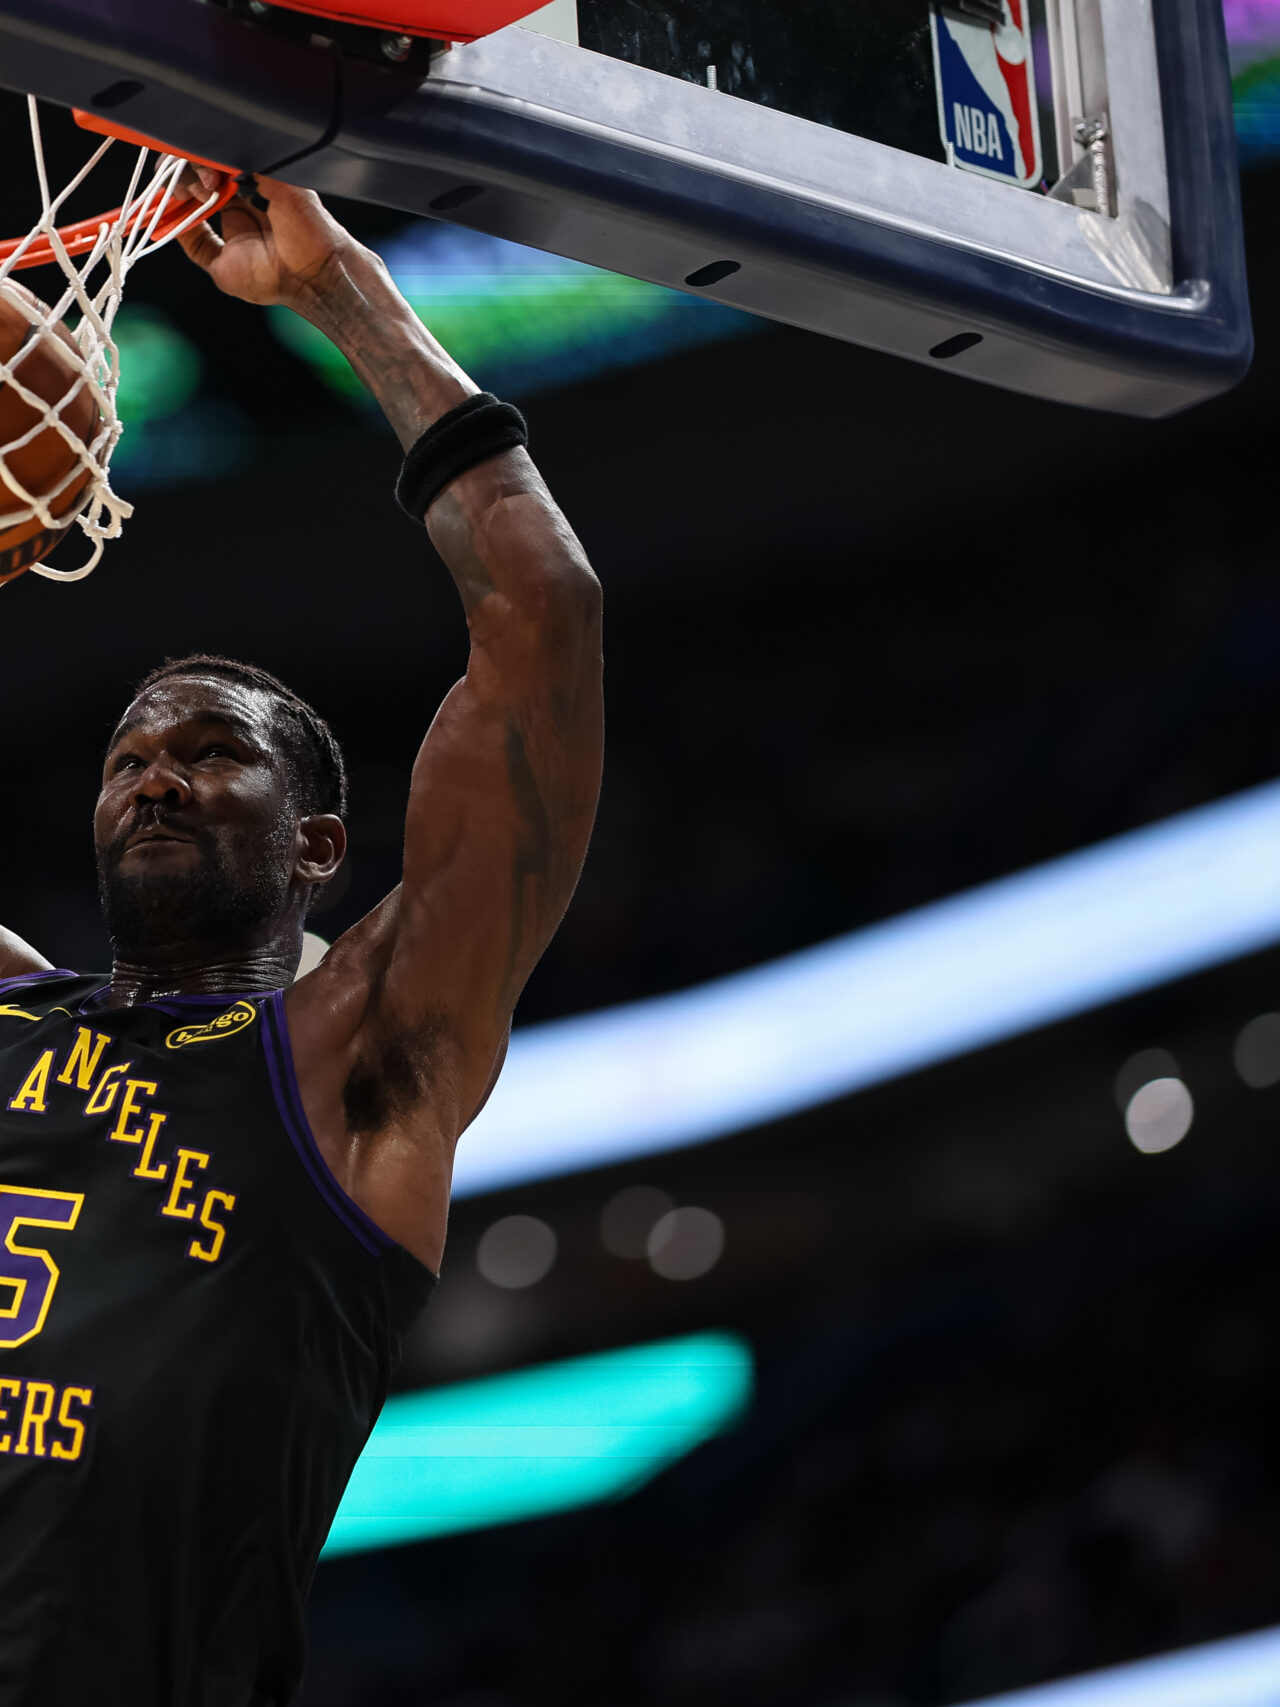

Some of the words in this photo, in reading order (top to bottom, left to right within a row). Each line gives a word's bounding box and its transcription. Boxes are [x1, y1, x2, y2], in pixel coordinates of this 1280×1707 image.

[952, 101, 1004, 161] NBA
[176, 1011, 250, 1042] bgo
[8, 1025, 237, 1263] ANGELES
